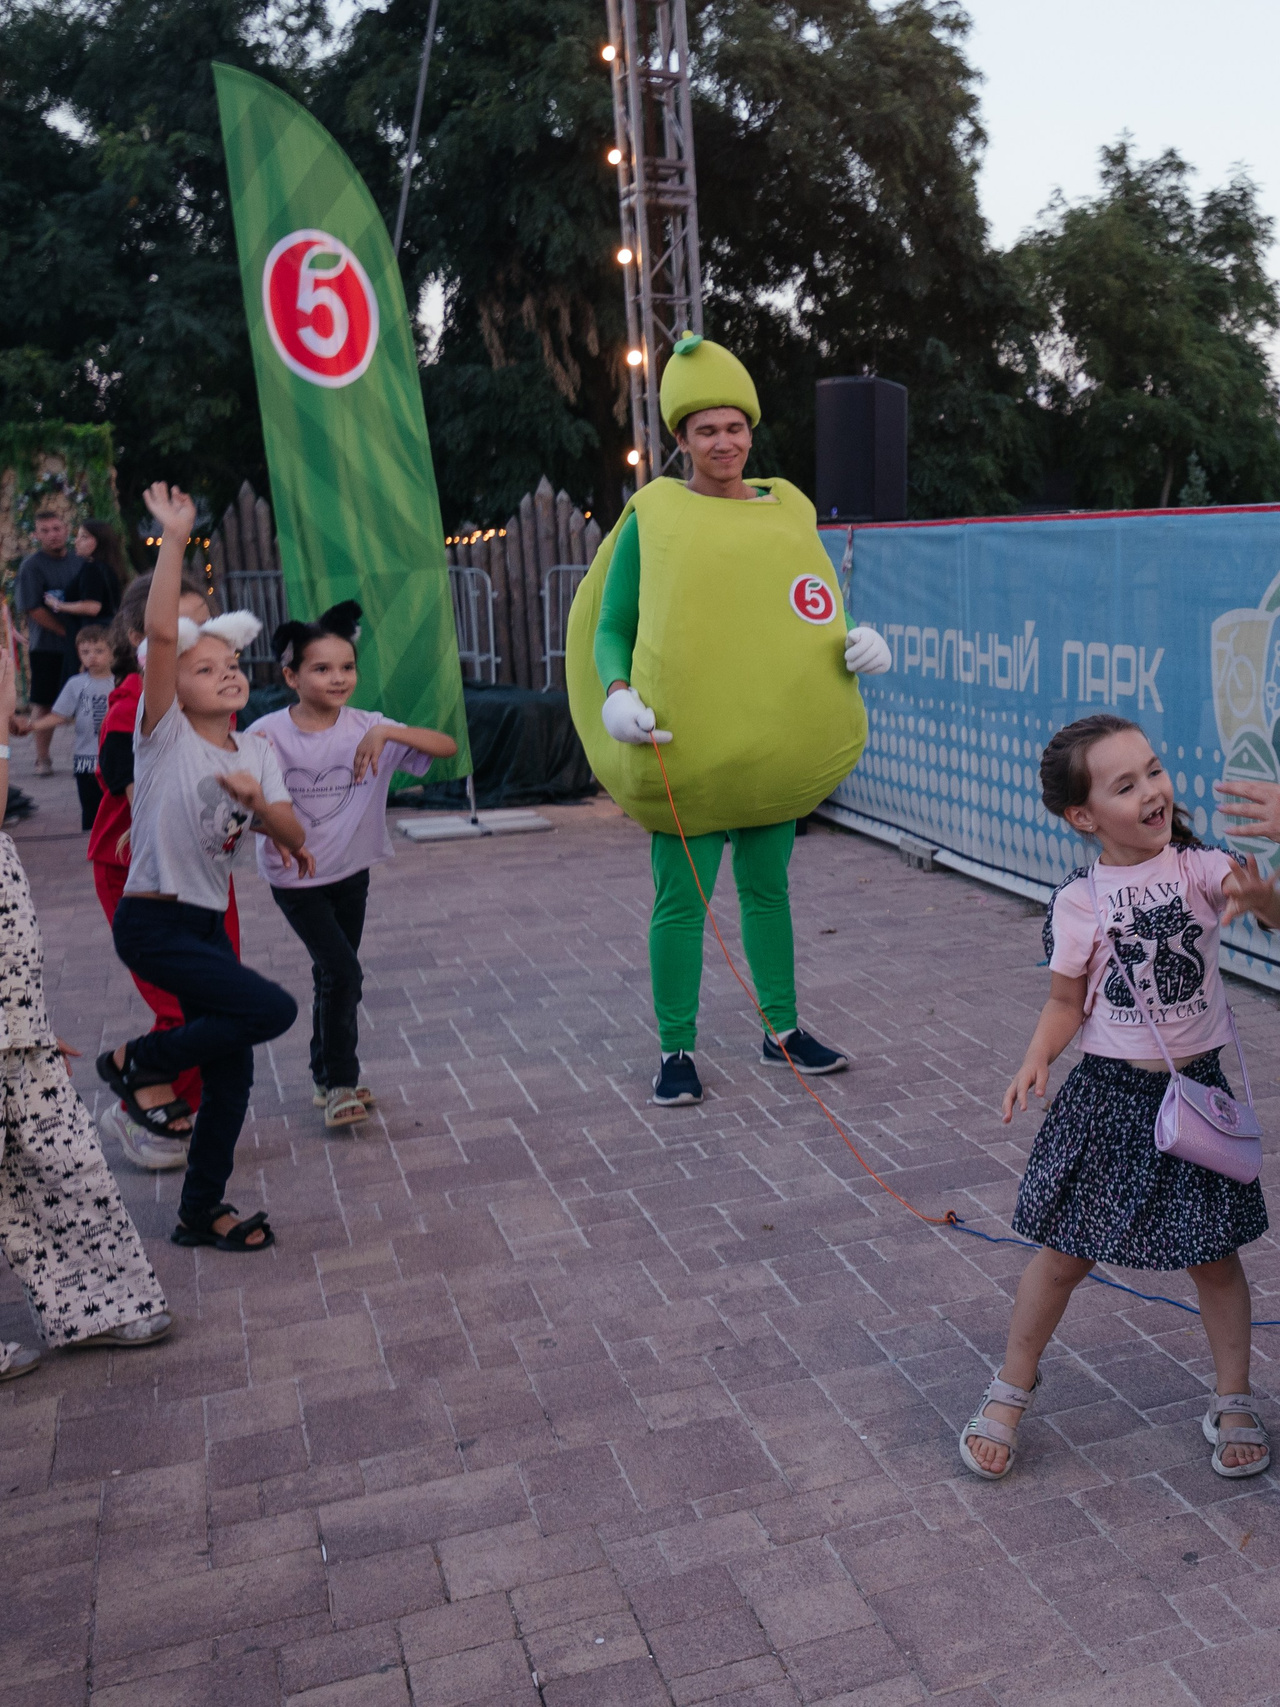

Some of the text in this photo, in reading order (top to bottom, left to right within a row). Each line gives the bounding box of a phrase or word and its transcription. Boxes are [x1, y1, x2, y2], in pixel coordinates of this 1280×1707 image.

[296, 243, 349, 358] 5
[859, 620, 1165, 713] ТРАЛЬНЫЙ ПАРК
[1108, 881, 1180, 910] MEAW
[1176, 999, 1205, 1019] CAT
